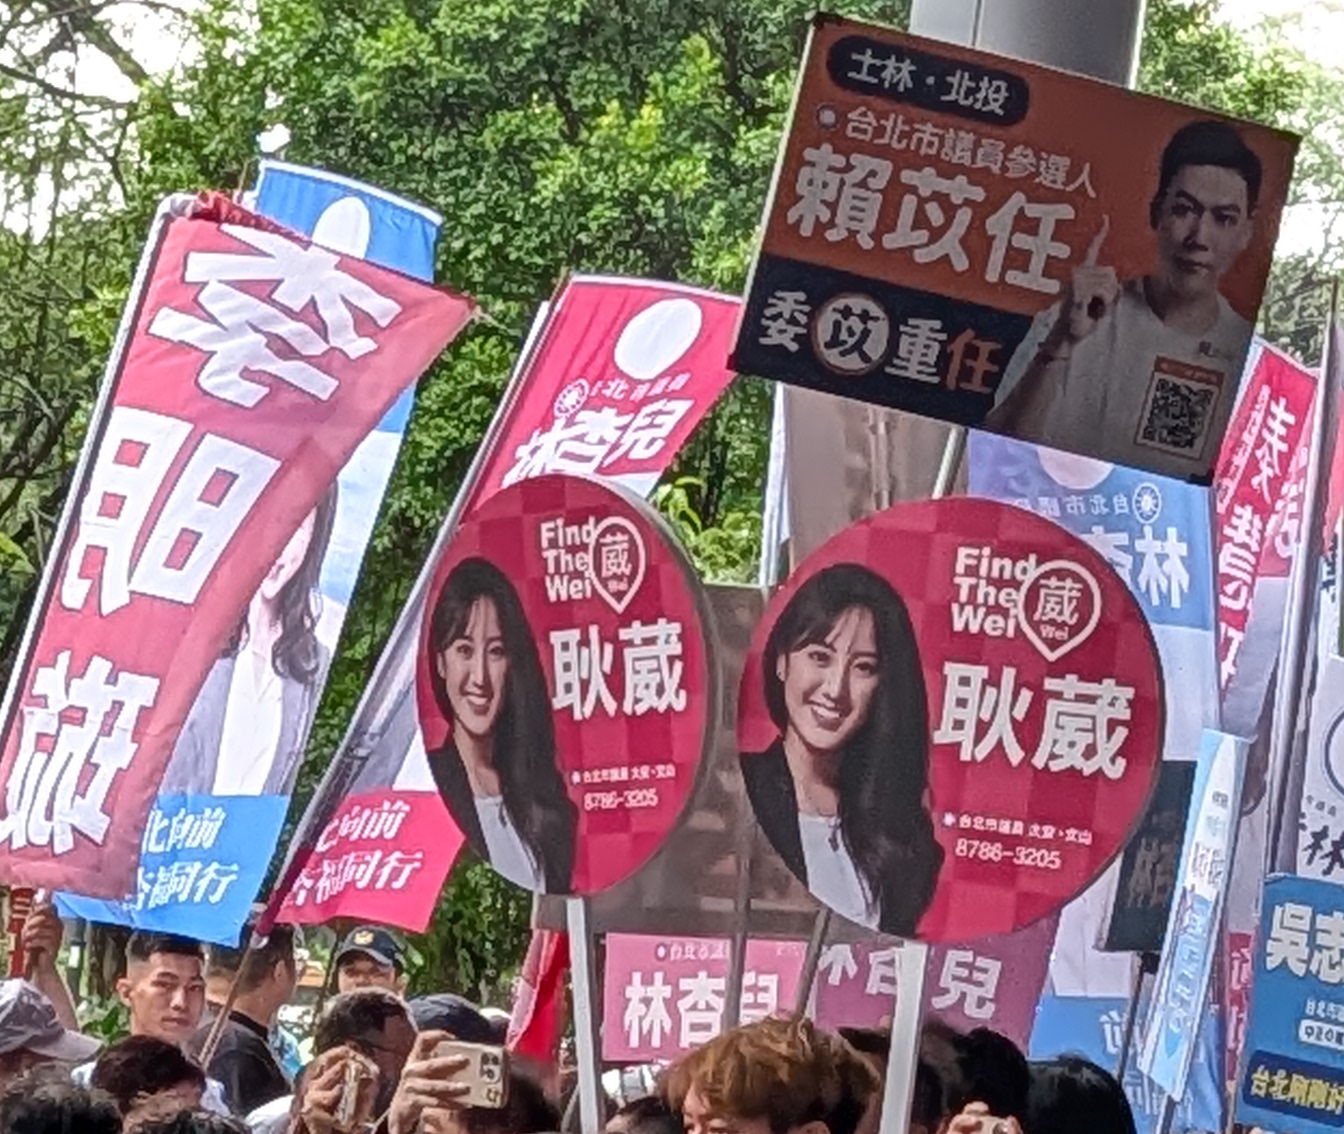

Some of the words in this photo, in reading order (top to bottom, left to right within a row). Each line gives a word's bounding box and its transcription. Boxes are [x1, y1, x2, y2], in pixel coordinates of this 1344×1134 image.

[844, 106, 1099, 199] 台北市議員參選人
[785, 142, 1078, 296] 賴苡任
[758, 290, 1004, 396] 委苡重任
[540, 516, 596, 549] Find
[541, 548, 590, 575] The
[954, 546, 1038, 582] Find
[544, 571, 593, 603] Wei
[953, 577, 1018, 608] The
[1032, 577, 1083, 628] 葳
[950, 602, 1017, 638] Wei
[548, 617, 688, 722] 耿葳
[933, 661, 1136, 780] 耿葳
[955, 837, 1062, 870] 8786-3205
